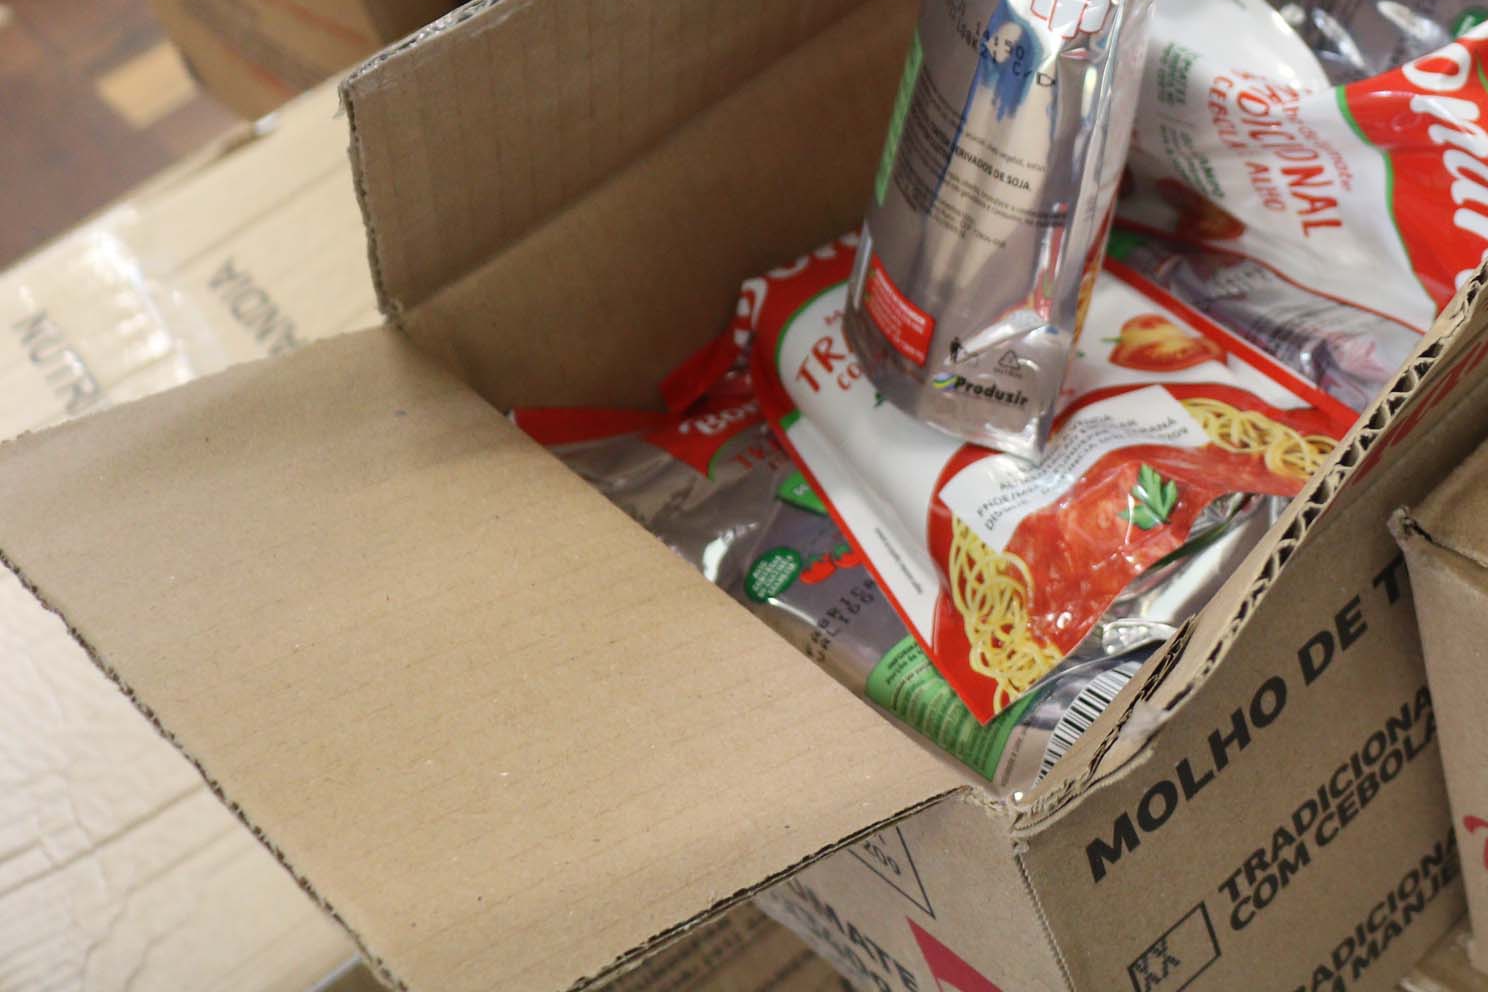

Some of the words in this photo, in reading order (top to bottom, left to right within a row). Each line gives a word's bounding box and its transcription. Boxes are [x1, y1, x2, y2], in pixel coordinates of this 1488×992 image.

[952, 374, 1029, 408] Produzir
[1084, 675, 1288, 884] MOLHO
[1297, 595, 1369, 687] DE
[1217, 684, 1434, 904] TRADICIONA
[1229, 840, 1312, 932] COM
